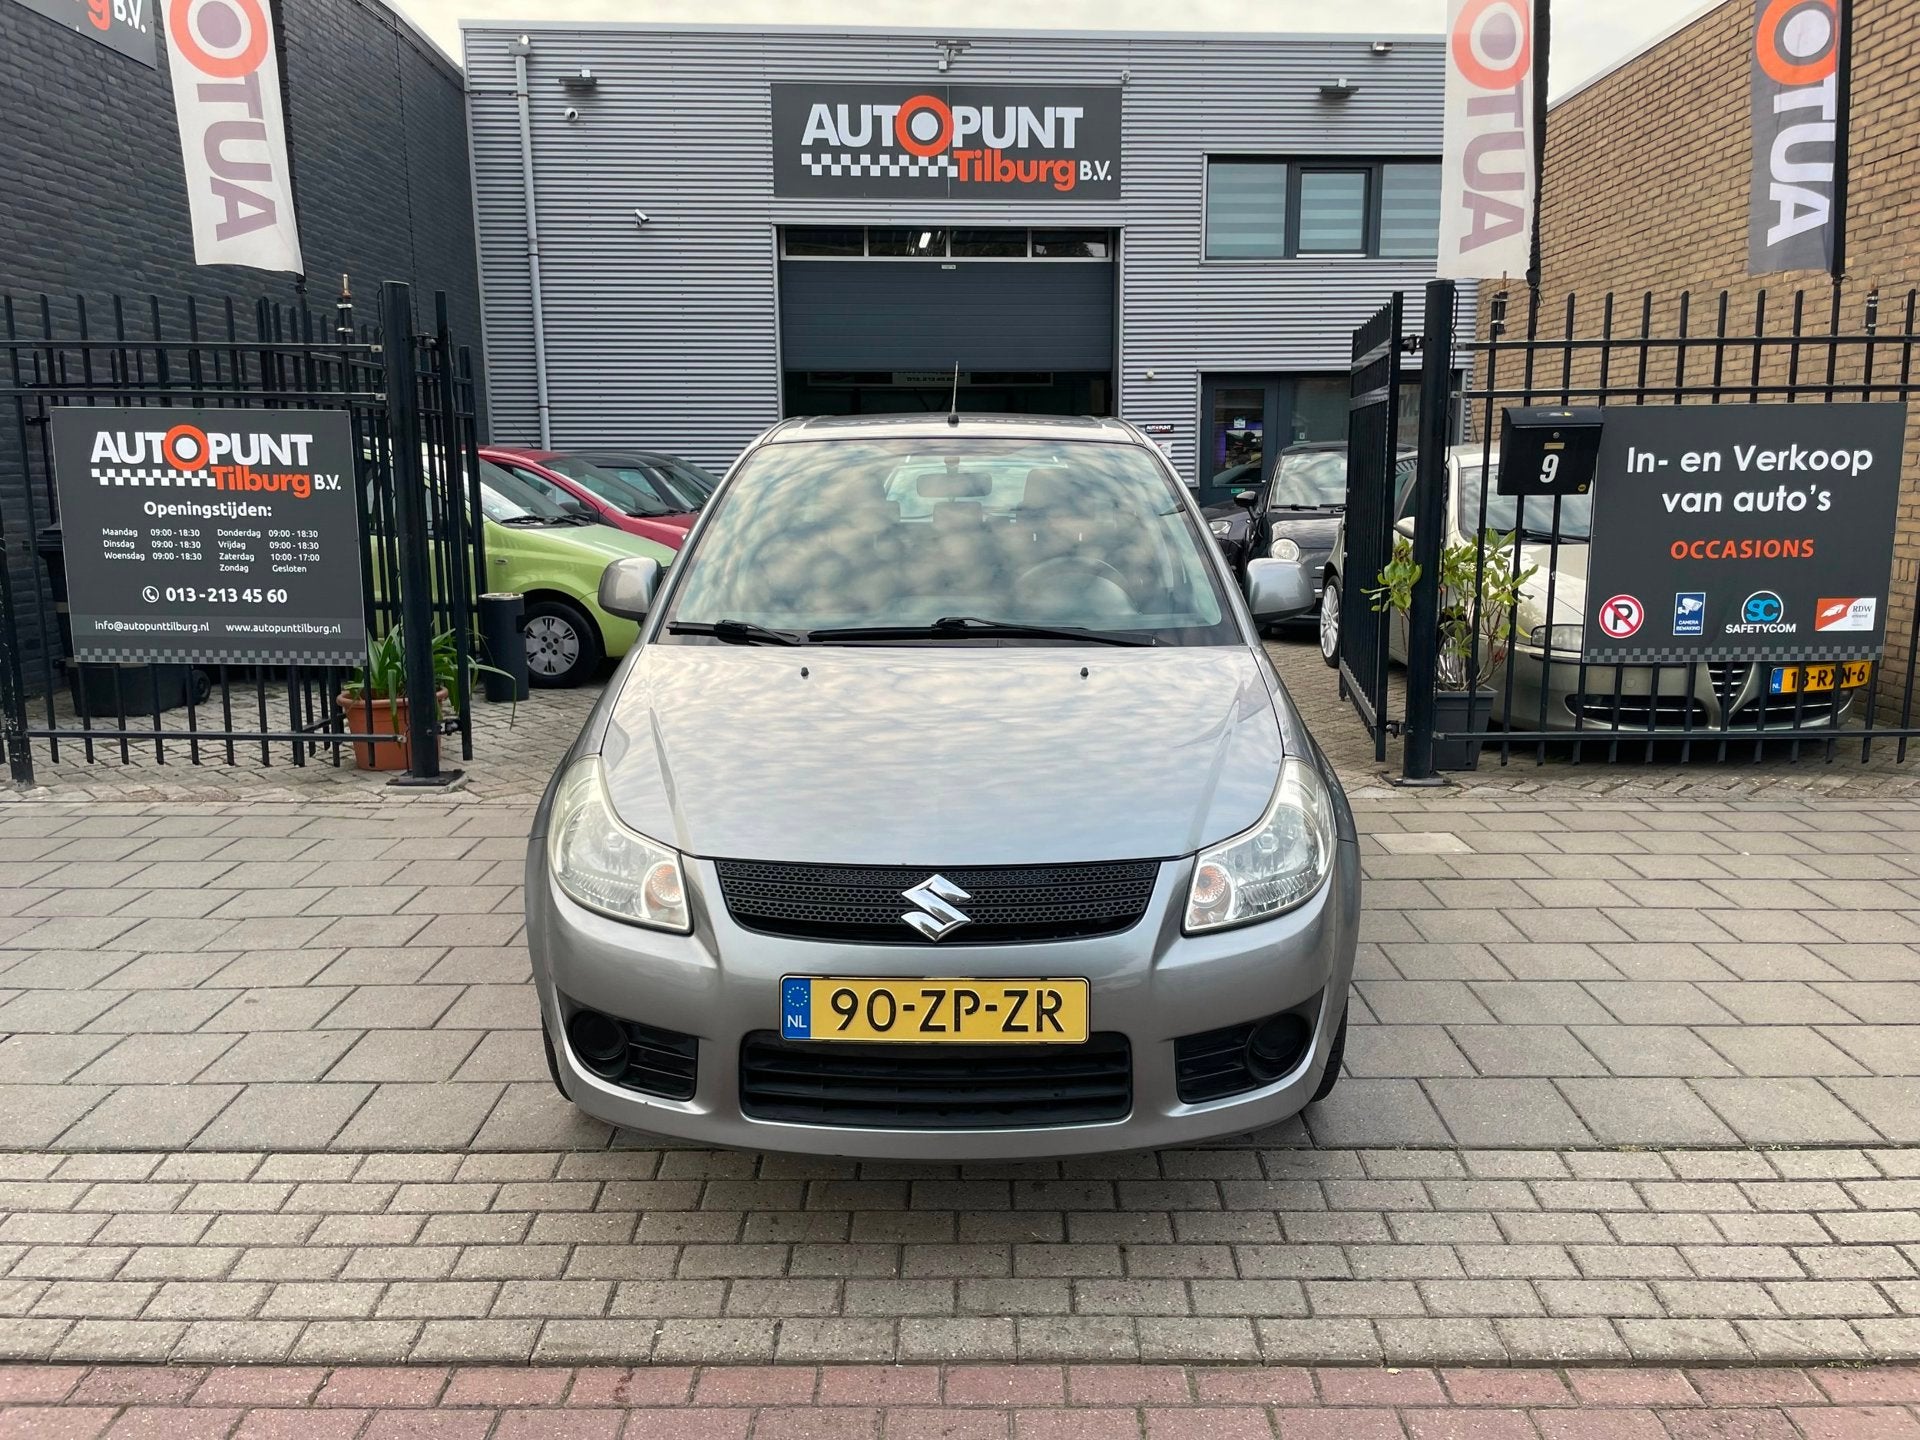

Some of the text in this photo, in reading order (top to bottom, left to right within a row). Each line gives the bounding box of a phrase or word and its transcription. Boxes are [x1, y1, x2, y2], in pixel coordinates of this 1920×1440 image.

[801, 95, 1083, 157] AUTOPUNT
[953, 149, 1112, 192] Tilburg B.V.
[90, 424, 313, 471] AUTOPUNT
[1540, 454, 1560, 483] 9
[1626, 444, 1873, 476] In- en Verkoop
[211, 465, 342, 498] Tilburg B.V.
[1662, 485, 1832, 513] van auto's
[144, 501, 272, 518] Openingstijden:
[102, 528, 138, 537] Maandag
[178, 529, 200, 537] 18:30
[217, 529, 261, 538] Donderdag
[103, 540, 135, 549] Dinsdag
[179, 541, 201, 549] 18:30
[218, 541, 246, 550] Vrijdag
[1670, 539, 1814, 560] OCCASIONS
[104, 552, 145, 561] Woensdag
[152, 552, 174, 560] 09:00
[219, 552, 255, 562] Zaterdag
[219, 564, 307, 573] Zondag Gesloten
[242, 589, 263, 603] 45
[267, 589, 288, 603] 60
[1746, 600, 1779, 622] SC
[95, 621, 341, 635] info@autopunttilburg.nl www.autopunttilburg.nl
[1725, 624, 1797, 634] SAFETYCOM
[787, 988, 1064, 1032] NL 90-ZP-ZR
